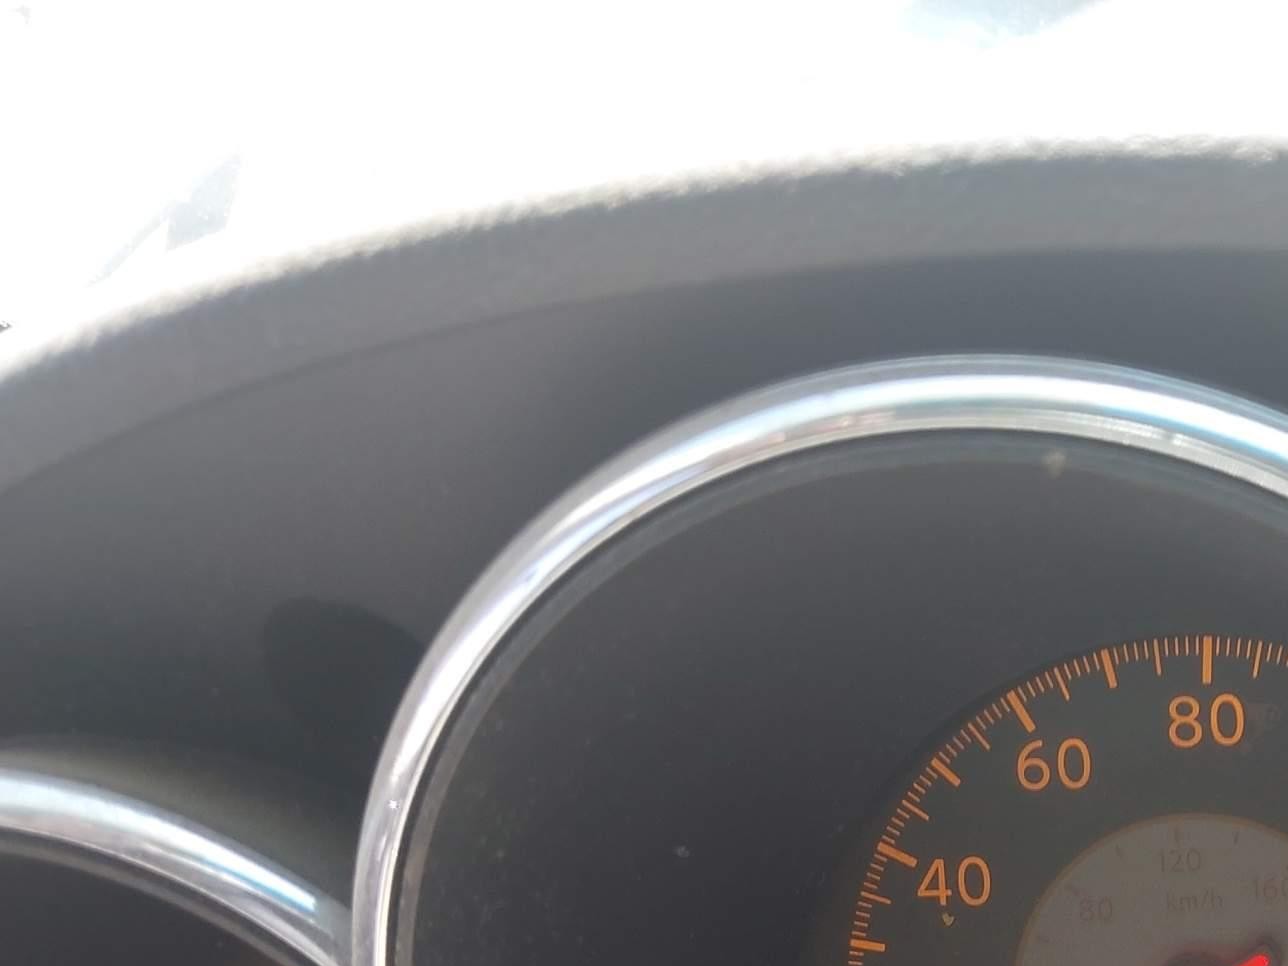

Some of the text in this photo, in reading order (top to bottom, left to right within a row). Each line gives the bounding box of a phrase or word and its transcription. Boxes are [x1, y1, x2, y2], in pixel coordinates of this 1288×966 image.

[1167, 693, 1246, 748] 80
[1016, 738, 1092, 790] 60
[917, 856, 992, 906] 40
